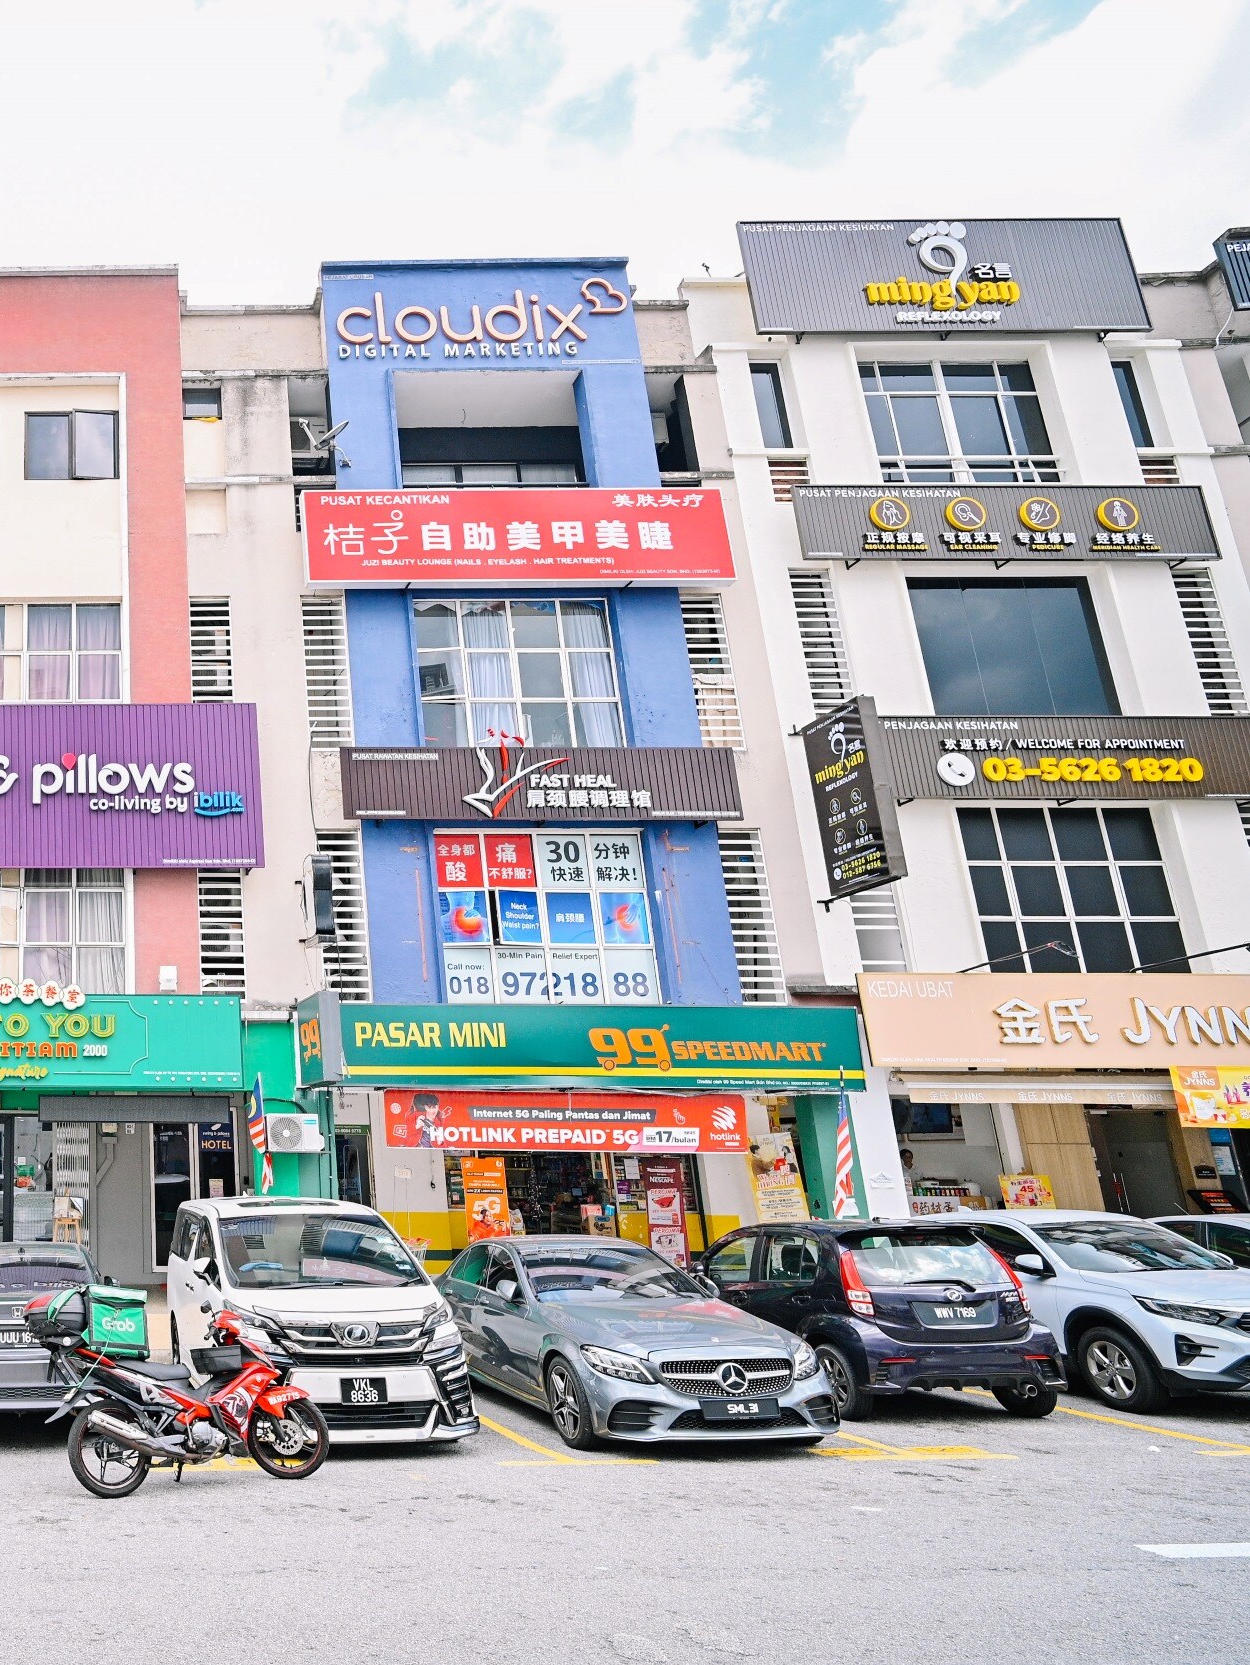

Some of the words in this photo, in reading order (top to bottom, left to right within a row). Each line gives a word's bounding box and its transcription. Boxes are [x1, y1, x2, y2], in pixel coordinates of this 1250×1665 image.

[743, 225, 774, 233] PUSAT
[775, 224, 837, 232] PENJAGAAN
[839, 223, 894, 231] KESIHATAN
[974, 262, 1012, 279] 名言
[866, 275, 956, 310] ming
[956, 280, 1021, 310] yan
[337, 289, 588, 344] cloudix
[896, 311, 1001, 323] REFLEXOLOGY
[339, 342, 431, 361] DIGITAL
[444, 341, 579, 357] MARKETING
[321, 496, 362, 505] PUSAT
[366, 495, 450, 505] KECANTIKAN
[799, 490, 832, 498] PUSAT
[834, 489, 899, 498] PENJAGAAN
[902, 489, 961, 498] KESIHATAN
[612, 494, 704, 508] 美肤头疗
[421, 520, 673, 551] 自助美甲美睫
[866, 532, 925, 543] 正规按摩
[943, 532, 1002, 543] 可视采耳
[1017, 531, 1077, 544] 专业修脚
[1096, 532, 1155, 545] 经络养生
[417, 558, 452, 566] LOUNGE
[454, 558, 481, 567] (NAILS
[488, 558, 527, 566] EYELASH
[534, 557, 554, 565] HAIR
[556, 557, 614, 565] TREATMENTS)
[884, 721, 952, 730] PENJAGAAN
[956, 721, 1018, 730] KESIHATAN
[943, 738, 1003, 750] 欢迎预约
[1016, 739, 1074, 749] WELCOME
[1077, 739, 1101, 749] FOR
[1105, 739, 1185, 749] APPOINTMENT
[815, 759, 844, 784] ming
[844, 750, 864, 775] yan
[982, 756, 1121, 783] 03-5626
[1122, 757, 1204, 782] 1820
[33, 752, 196, 804] pillows
[530, 774, 570, 788] FAST
[574, 774, 617, 788] HEAL
[825, 771, 858, 792] REFLEXOLOGY
[89, 795, 161, 814] co-living
[165, 794, 187, 813] by
[194, 791, 244, 808] ibilik
[527, 789, 652, 809] 肩颈腰调理馆
[437, 844, 475, 856] 全身都
[495, 843, 517, 863] 痛
[545, 840, 580, 863] 30
[594, 843, 630, 860] 分钟
[841, 857, 865, 871] 03-5626
[866, 851, 881, 861] 1820
[445, 861, 467, 882] 酸
[488, 867, 532, 880] 不舒服?
[550, 866, 585, 882] 快速
[596, 866, 638, 882] 解决!
[511, 903, 527, 911] Neck
[505, 911, 535, 920] Shoulder
[555, 912, 585, 923] 肩颈腰
[502, 920, 521, 929] Waist
[521, 921, 540, 930] pain?
[552, 952, 573, 960] Relief
[574, 953, 598, 961] Expert
[465, 963, 485, 971] now:
[449, 976, 490, 995] 018
[613, 972, 650, 997] 88
[867, 981, 913, 998] KEDAI
[916, 981, 954, 998] UBAT
[41, 1013, 116, 1038] YOU
[993, 997, 1100, 1044] 金氏
[1120, 997, 1250, 1045] JYNN
[83, 1044, 108, 1057] 2000
[354, 1022, 441, 1048] PASAR
[449, 1022, 507, 1048] MINI
[588, 1024, 673, 1072] 99
[671, 1041, 823, 1062] SPEEDMART
[1184, 1078, 1216, 1086] JYNNS
[952, 1091, 985, 1101] JYNNS
[1018, 1092, 1038, 1101] 金氏
[1041, 1091, 1073, 1101] JYNNS
[1131, 1092, 1162, 1102] JYNNS
[474, 1108, 514, 1118] Internet
[515, 1109, 529, 1119] 5G
[532, 1109, 563, 1120] Paling
[566, 1110, 599, 1120] Pantas
[601, 1111, 621, 1120] dan
[623, 1111, 651, 1120] Jimat
[429, 1126, 517, 1143] HOTLINK
[521, 1128, 607, 1145] PREPAID
[612, 1129, 639, 1145] 5G
[710, 1132, 741, 1141] hotlink
[202, 1140, 231, 1150] HOTEL
[757, 1180, 784, 1189] HIRING
[472, 1197, 500, 1221] 5G
[934, 1307, 954, 1318] WWV
[954, 1307, 976, 1318] 7169
[101, 1317, 136, 1333] Grab
[0, 1332, 20, 1344] UUU
[353, 1379, 373, 1391] VKL
[351, 1390, 378, 1402] 8636
